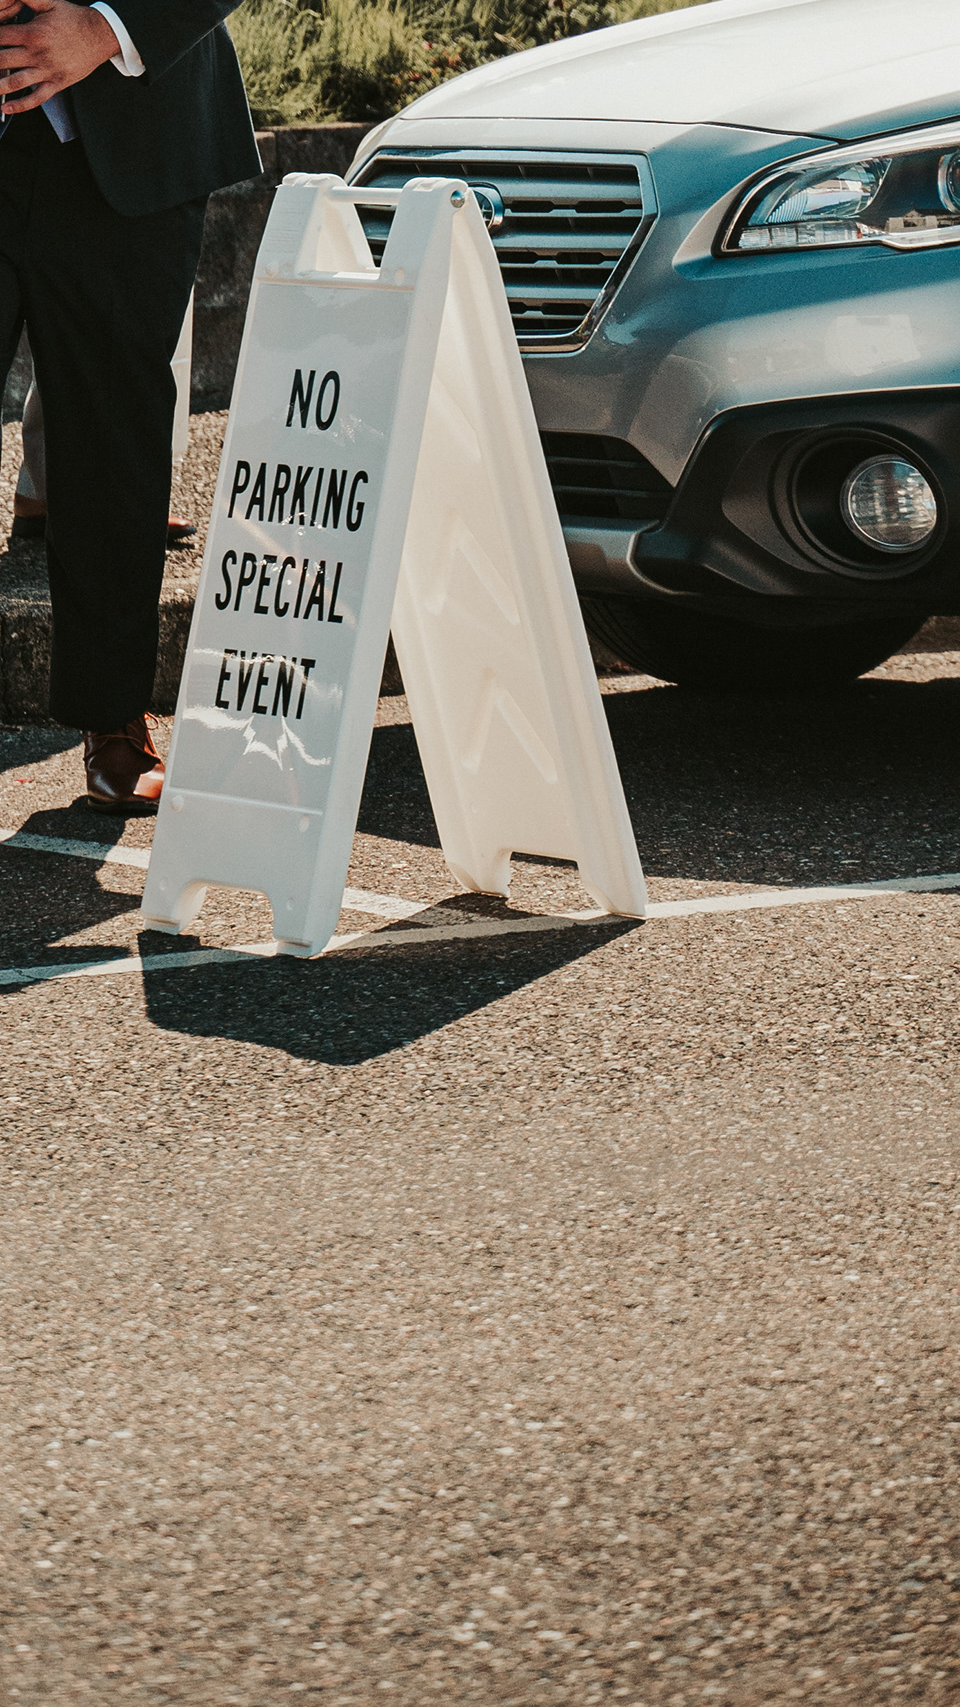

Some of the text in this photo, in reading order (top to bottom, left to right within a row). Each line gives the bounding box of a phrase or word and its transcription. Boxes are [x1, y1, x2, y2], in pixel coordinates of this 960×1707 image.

[285, 368, 341, 431] NO
[227, 459, 369, 532] PARKING
[214, 549, 344, 624] SPECIAL
[214, 648, 317, 720] EVENT
